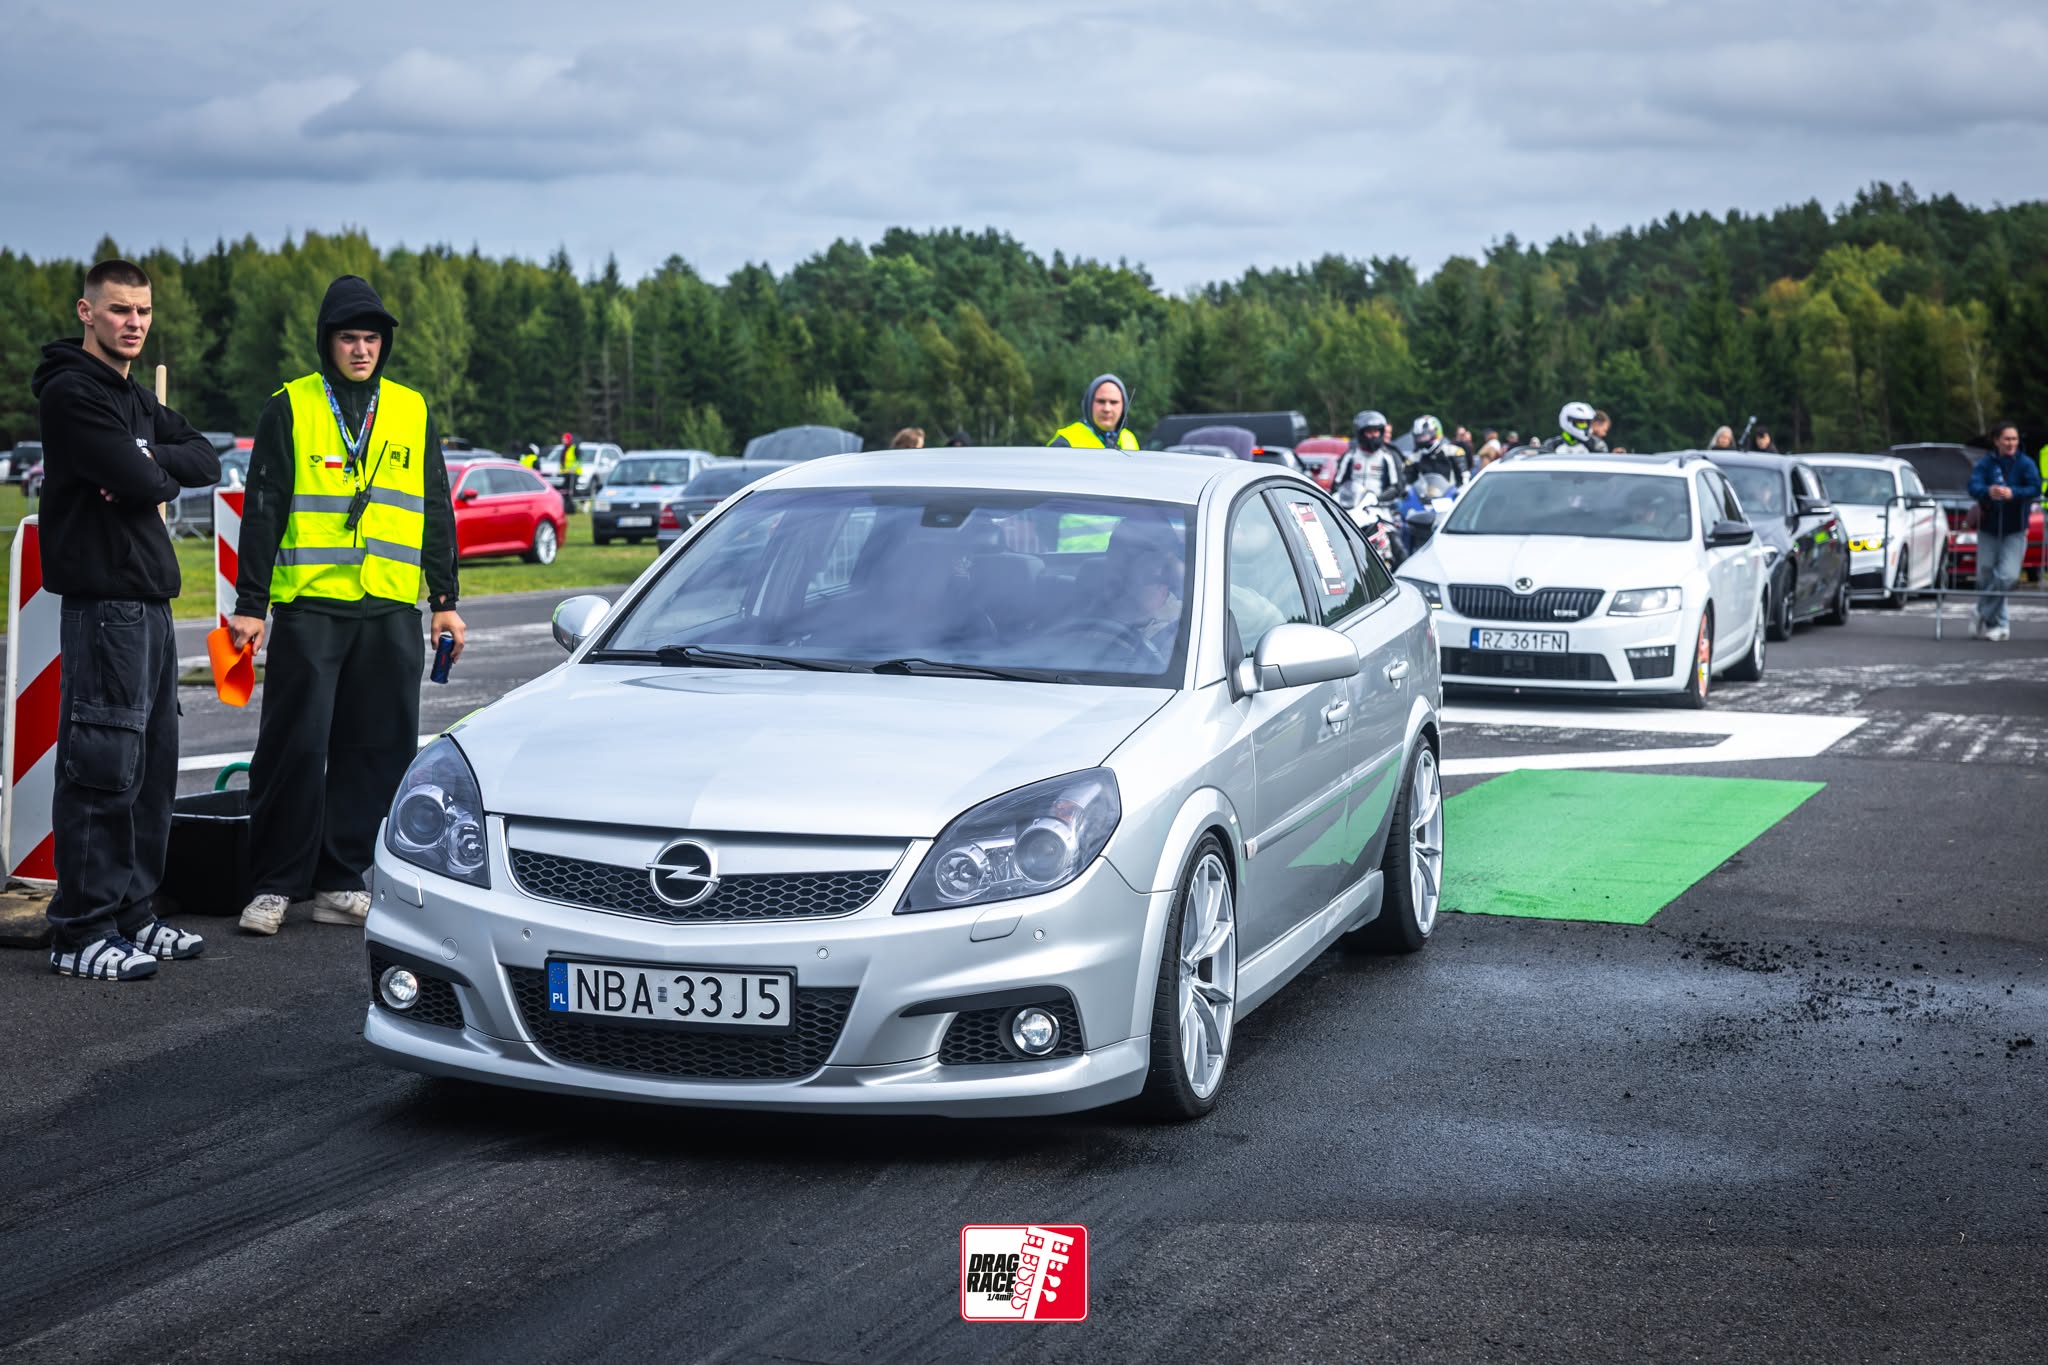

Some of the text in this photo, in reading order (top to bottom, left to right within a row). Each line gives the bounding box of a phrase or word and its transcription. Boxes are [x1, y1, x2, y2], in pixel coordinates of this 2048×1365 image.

[1482, 631, 1563, 650] RZ 361FN
[552, 992, 566, 1005] PL
[576, 968, 780, 1020] NBA 33J5
